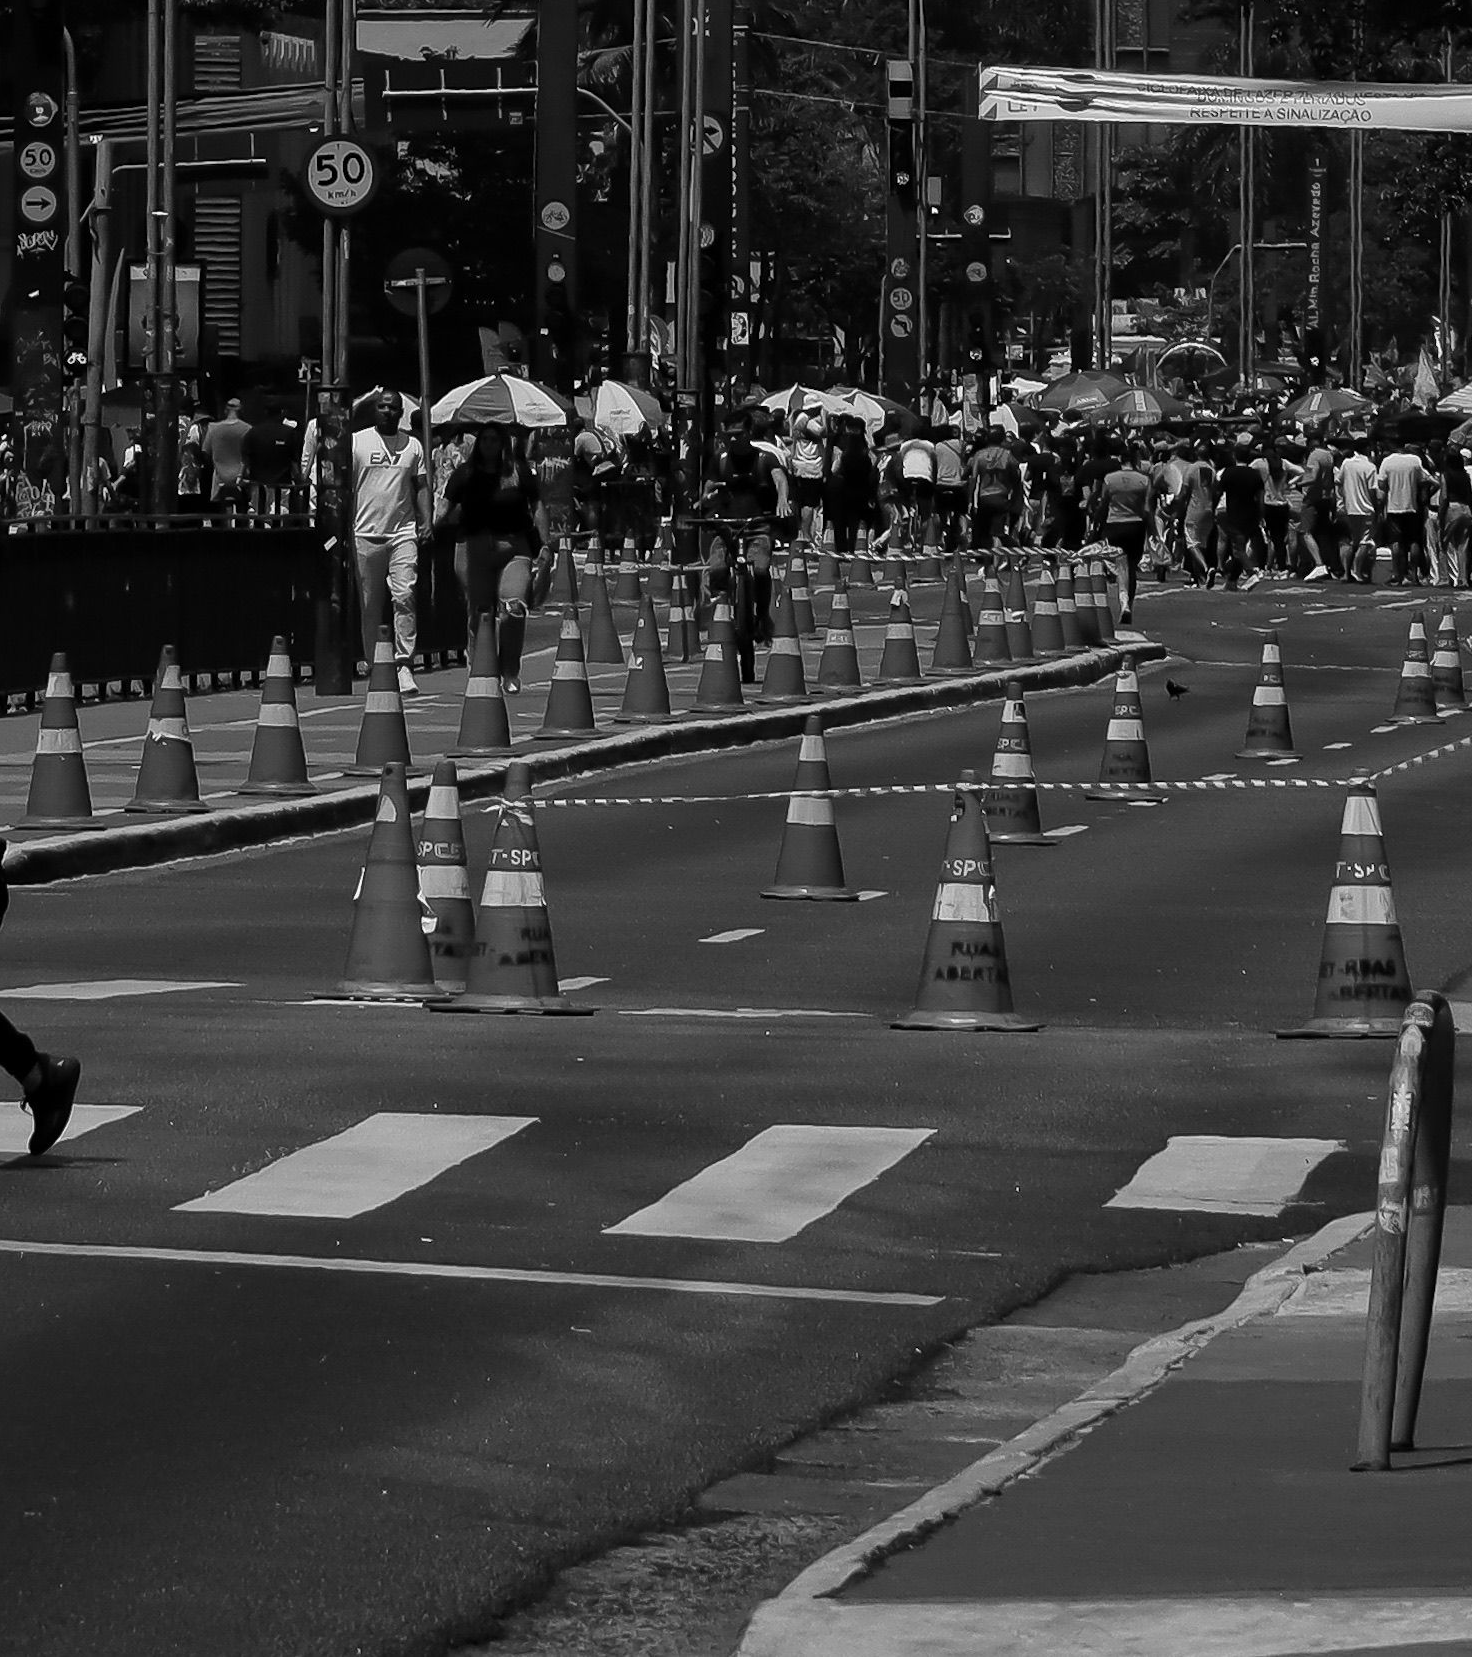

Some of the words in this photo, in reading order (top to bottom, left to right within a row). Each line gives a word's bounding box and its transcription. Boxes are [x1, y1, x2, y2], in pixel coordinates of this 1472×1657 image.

[1276, 108, 1372, 124] SINALIZAÇÃO
[25, 149, 52, 166] 50
[316, 152, 365, 186] 50
